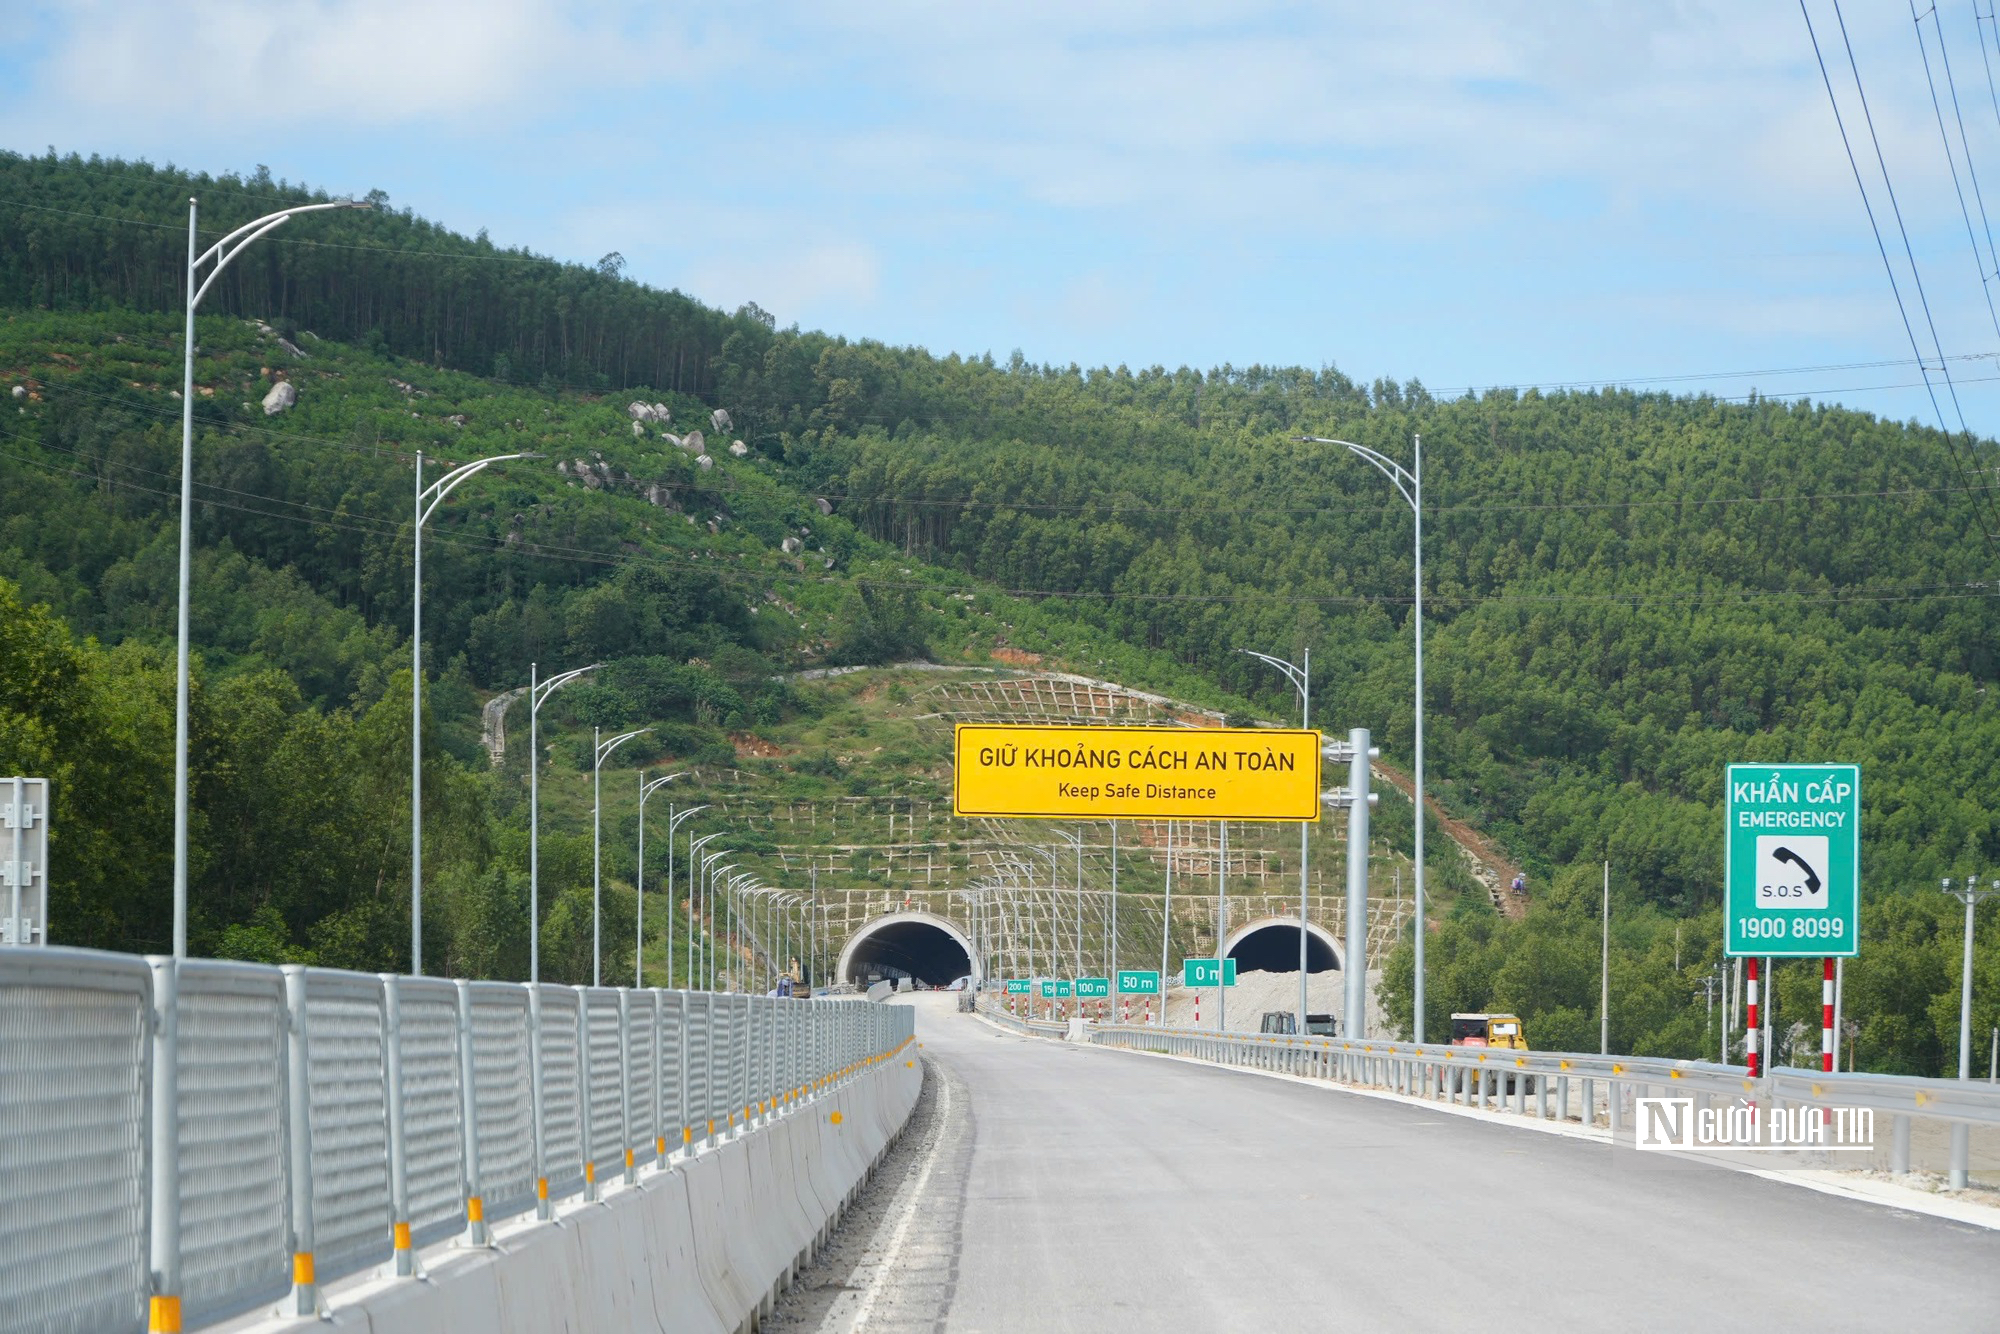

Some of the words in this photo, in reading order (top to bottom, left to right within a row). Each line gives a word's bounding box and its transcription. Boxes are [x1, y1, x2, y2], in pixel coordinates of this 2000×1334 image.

[980, 743, 1018, 767] GIỮ
[1025, 743, 1121, 769] KHOẢNG
[1128, 745, 1187, 770] CÁCH
[1195, 751, 1227, 771] AN
[1234, 747, 1294, 772] TOÀN
[1059, 782, 1100, 801] Keep
[1105, 783, 1140, 798] Safe
[1146, 783, 1216, 799] Distance
[1734, 772, 1798, 804] KHẨN
[1805, 774, 1851, 804] CẤP
[1739, 811, 1846, 828] EMERGENCY
[1762, 885, 1803, 898] S.O.S
[1739, 917, 1786, 939] 1900
[1792, 917, 1844, 939] 8099
[1195, 966, 1205, 980] 0
[1008, 983, 1021, 991] 200
[1078, 983, 1094, 993] 100
[1096, 985, 1106, 993] m
[1123, 976, 1138, 988] 50
[1141, 979, 1153, 989] m
[1060, 986, 1069, 994] m
